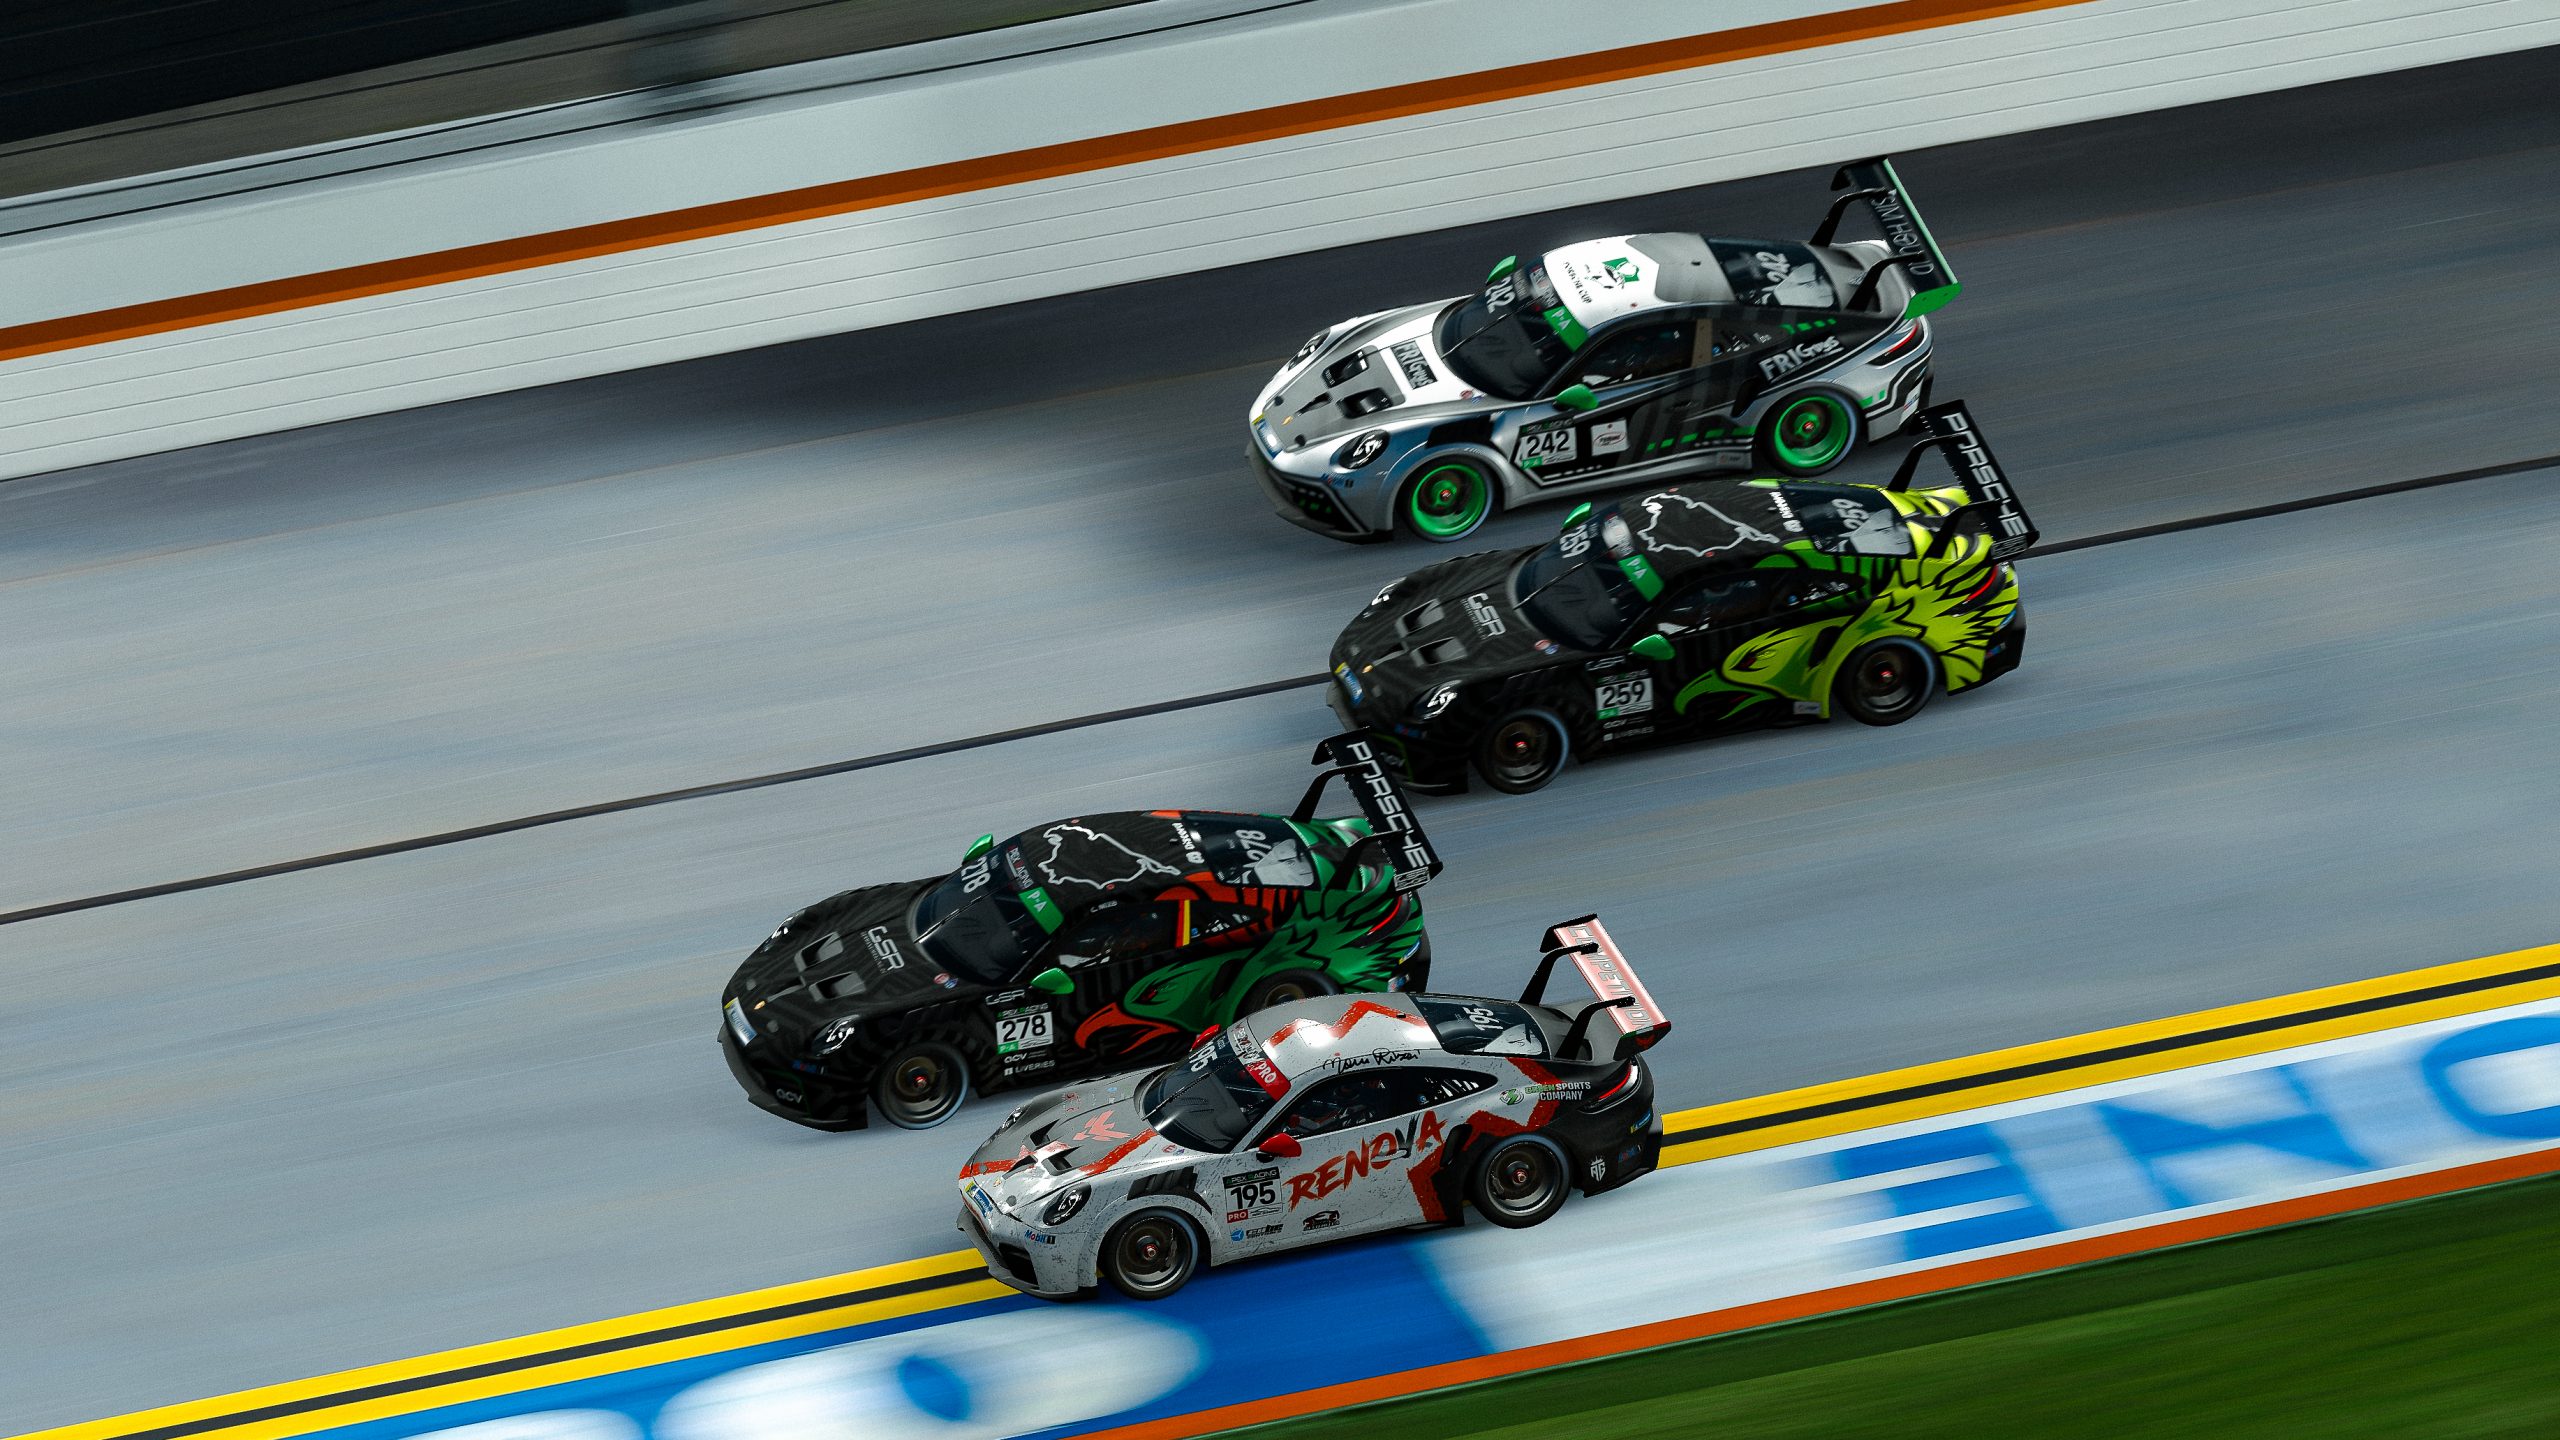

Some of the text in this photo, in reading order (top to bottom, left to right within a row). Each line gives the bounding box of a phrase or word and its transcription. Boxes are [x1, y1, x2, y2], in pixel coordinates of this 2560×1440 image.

[1485, 276, 1516, 313] 242
[1526, 431, 1571, 456] 242
[1941, 412, 2028, 537] PORSCHE
[1560, 524, 1591, 558] 259
[1602, 681, 1645, 707] 259
[1346, 741, 1431, 868] PORSCHE
[1235, 829, 1272, 861] 278
[961, 856, 991, 893] 278
[868, 926, 904, 971] GSR
[1002, 1015, 1046, 1042] 278
[1462, 1006, 1504, 1031] 195
[1189, 1041, 1218, 1072] 195
[1258, 1060, 1277, 1083] PRO
[1556, 1081, 1591, 1090] SPORTS
[1539, 1090, 1583, 1101] COMPANY
[1248, 1169, 1278, 1180] RACING
[1282, 1110, 1448, 1212] RENOVA
[1231, 1181, 1275, 1209] 195
[1228, 1211, 1247, 1221] PRO
